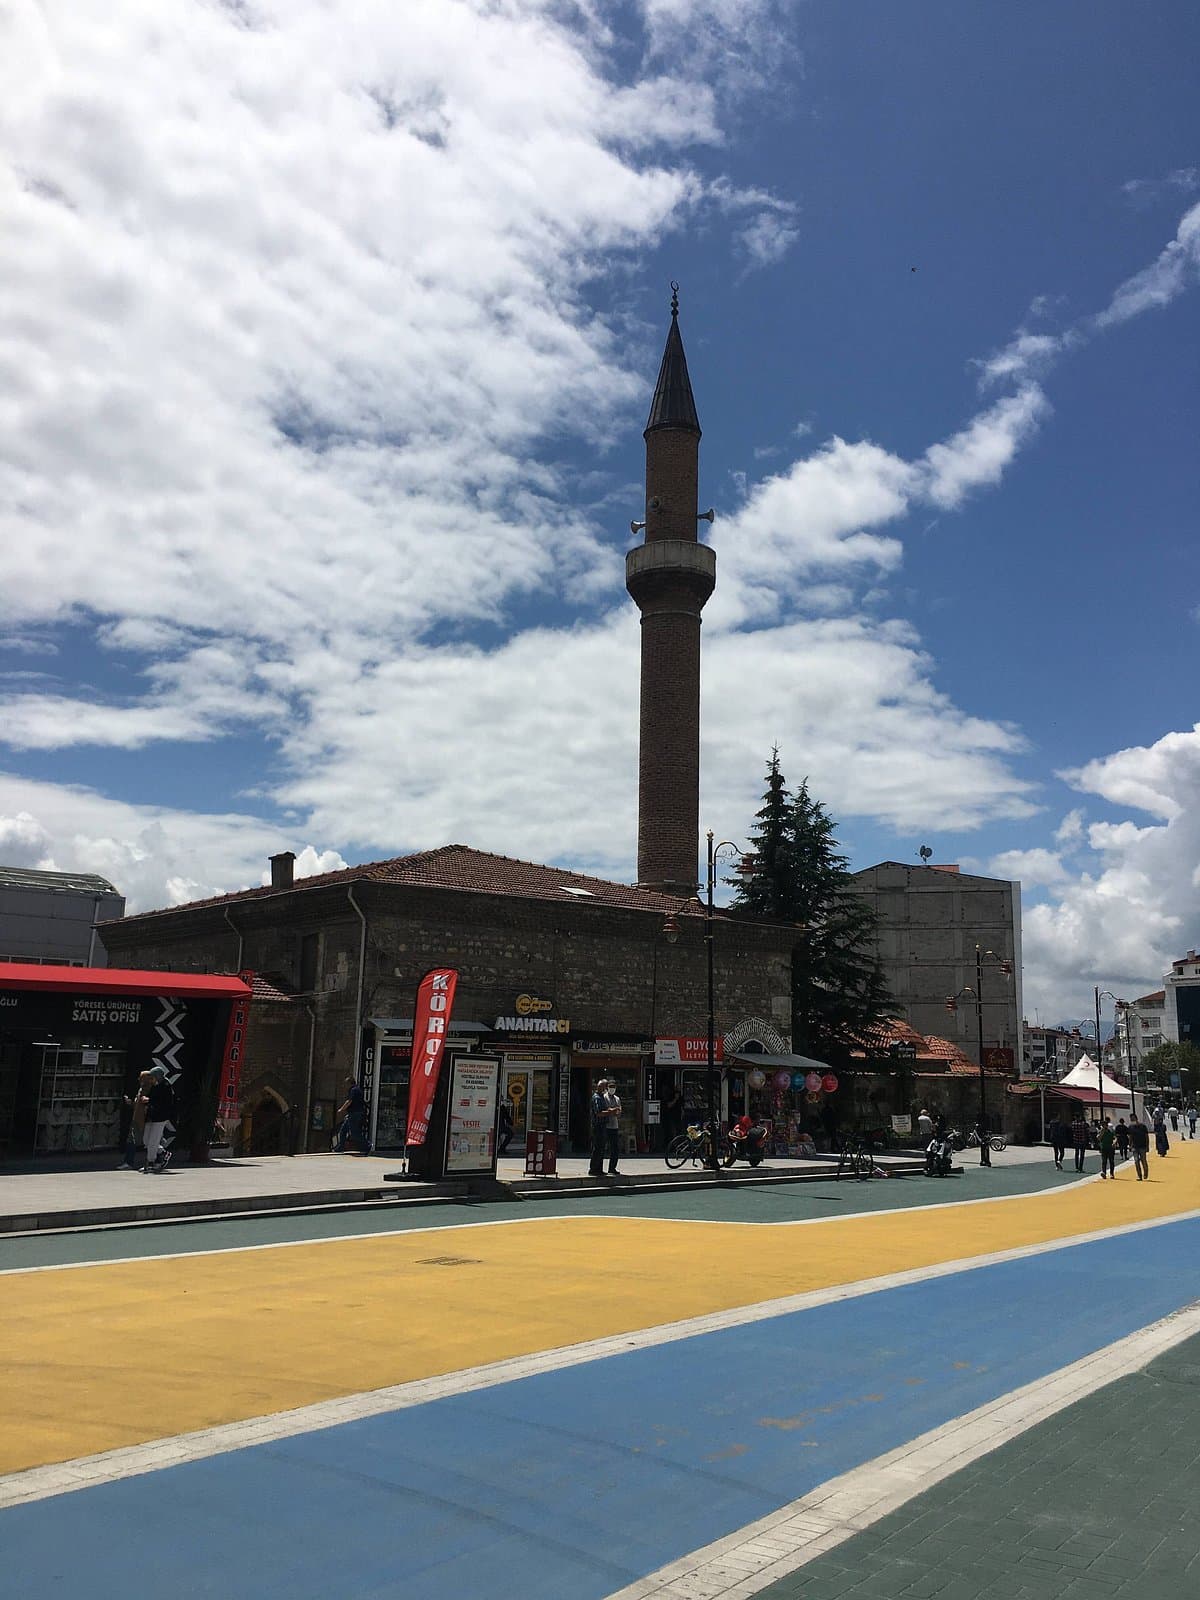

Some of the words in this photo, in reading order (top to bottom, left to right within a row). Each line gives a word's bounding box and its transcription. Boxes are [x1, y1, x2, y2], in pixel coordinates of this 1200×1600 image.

[74, 1000, 106, 1009] YÖRESEL
[107, 1000, 142, 1011] ÜRÜNLER
[72, 1009, 107, 1024] SATIŞ
[109, 1010, 140, 1023] OFİSİ
[494, 1016, 570, 1033] ANAHTARCI
